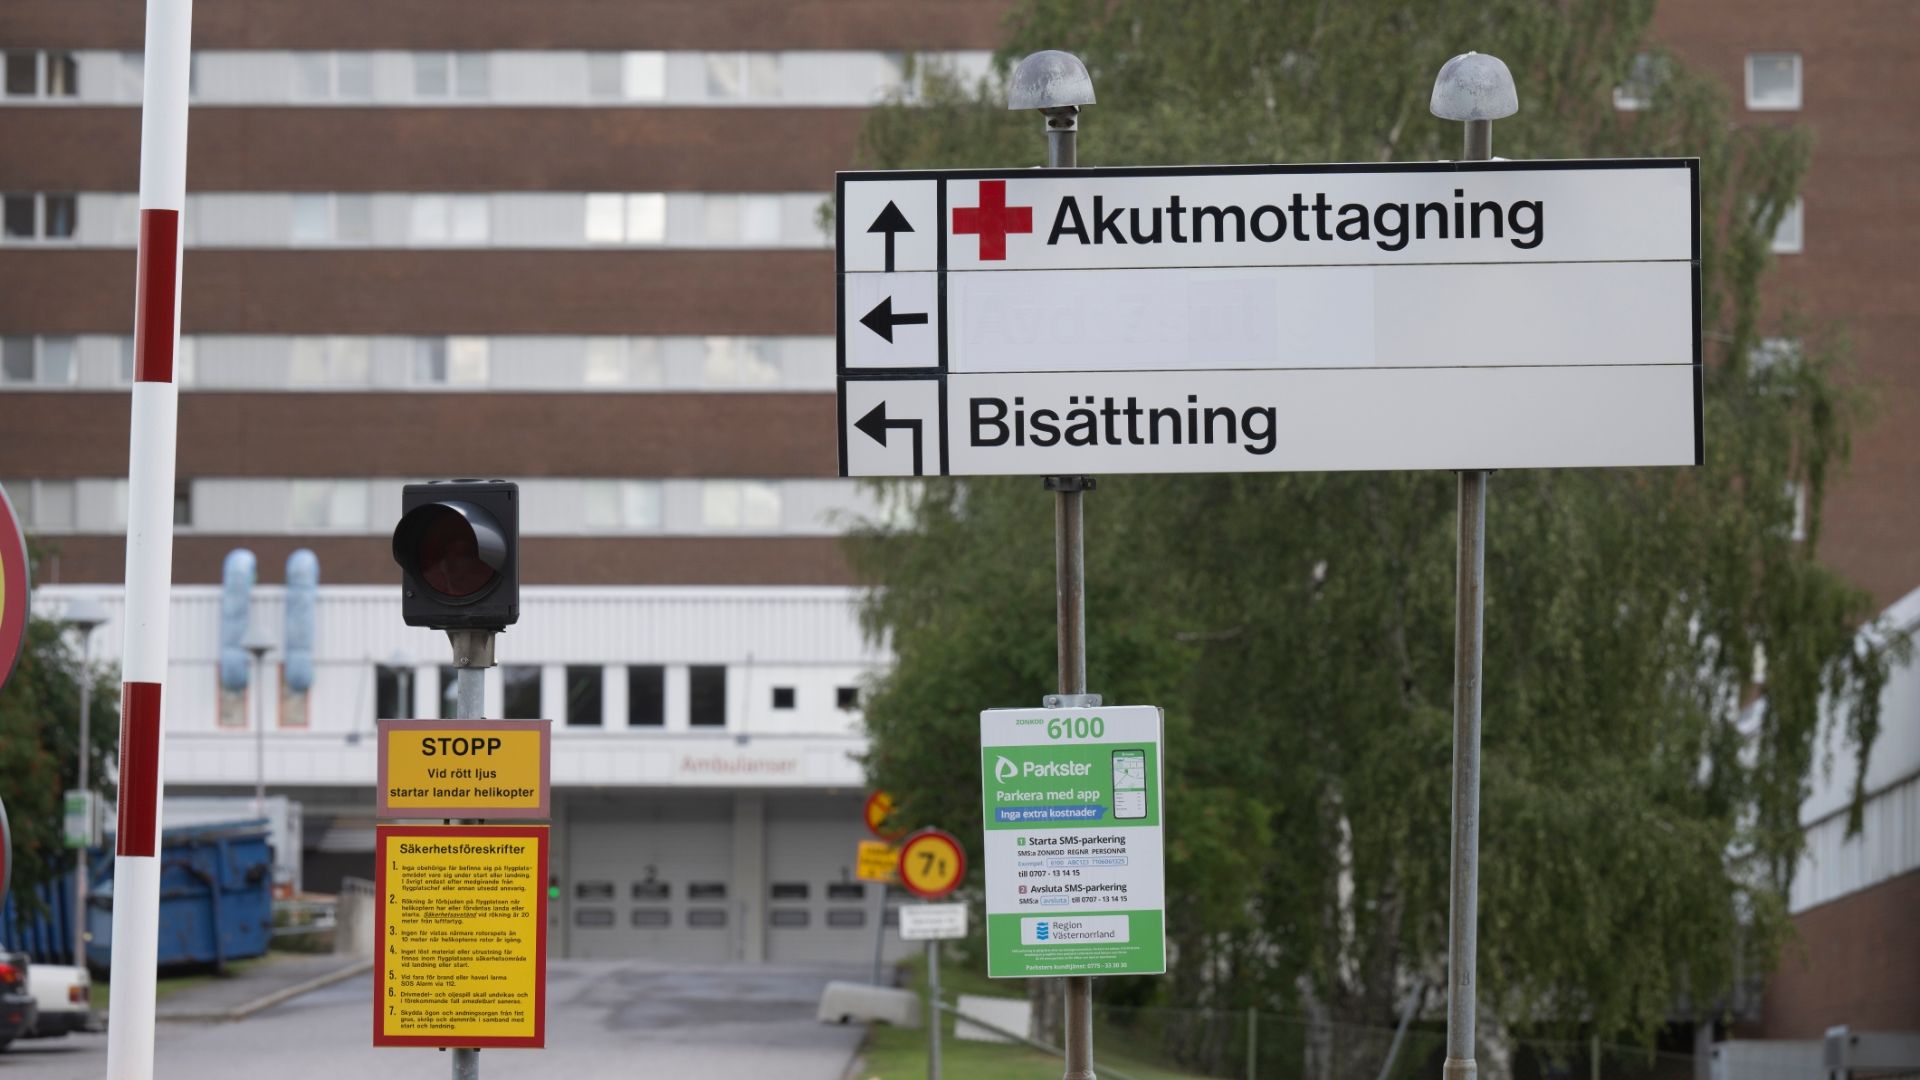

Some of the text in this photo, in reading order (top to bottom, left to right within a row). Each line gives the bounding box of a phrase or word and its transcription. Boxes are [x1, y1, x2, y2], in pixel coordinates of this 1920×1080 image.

[1048, 188, 1544, 250] Akutmottagning
[970, 394, 1278, 454] Bisättning
[1047, 717, 1104, 739] 6100
[422, 738, 502, 756] STOPP
[428, 769, 496, 780] Vid rött ljus
[1024, 761, 1091, 777] Parkster
[390, 788, 534, 799] startar landar helikopter
[997, 789, 1100, 802] Parkera med app
[1001, 808, 1096, 821] Inga extra kostnader
[1029, 837, 1057, 846] Starta
[1060, 835, 1125, 846] SMS-parkering
[400, 844, 525, 854] Säkerhetsföreskrifter
[392, 860, 398, 871] 1.
[1031, 885, 1062, 894] Avsluta
[1065, 883, 1127, 893] SMS-parkering
[390, 894, 397, 904] 2.
[390, 926, 397, 936] 3.
[1053, 921, 1082, 931] Region
[1053, 930, 1115, 940] Västernorrland
[390, 945, 397, 954] 4.
[389, 970, 396, 980] 5.
[389, 987, 396, 997] 6.
[389, 1006, 396, 1016] 7.
